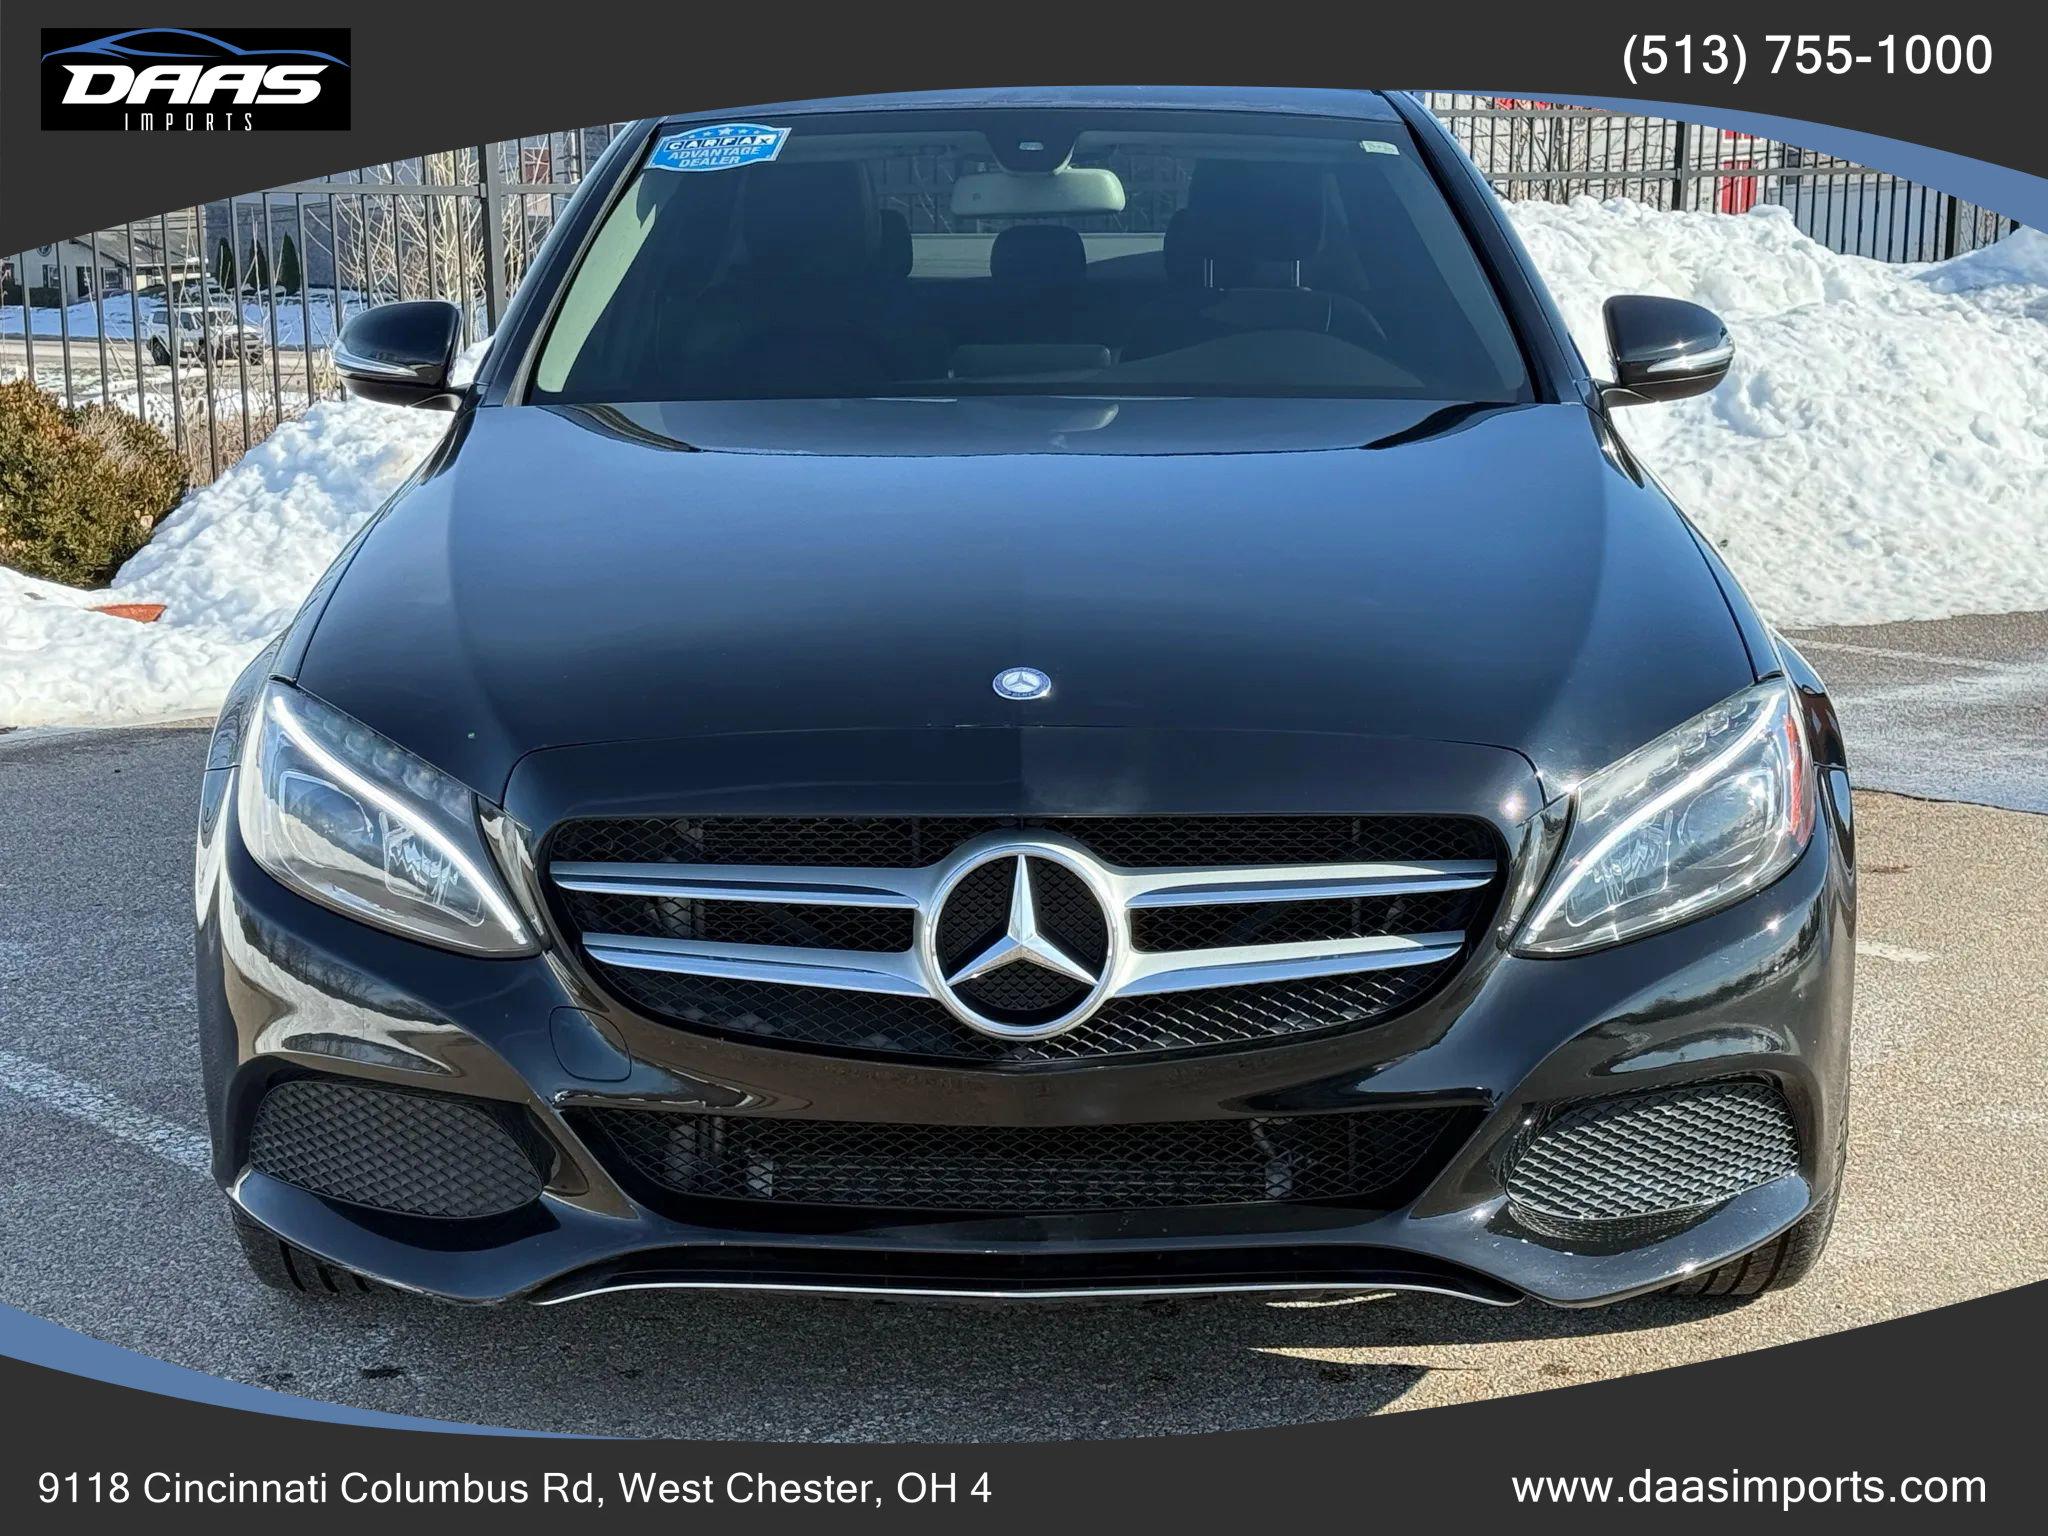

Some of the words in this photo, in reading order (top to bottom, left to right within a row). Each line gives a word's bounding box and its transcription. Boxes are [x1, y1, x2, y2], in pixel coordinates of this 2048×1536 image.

[667, 135, 773, 151] CARFAX
[668, 147, 762, 160] ADVANTAGE
[679, 156, 741, 168] DEALER
